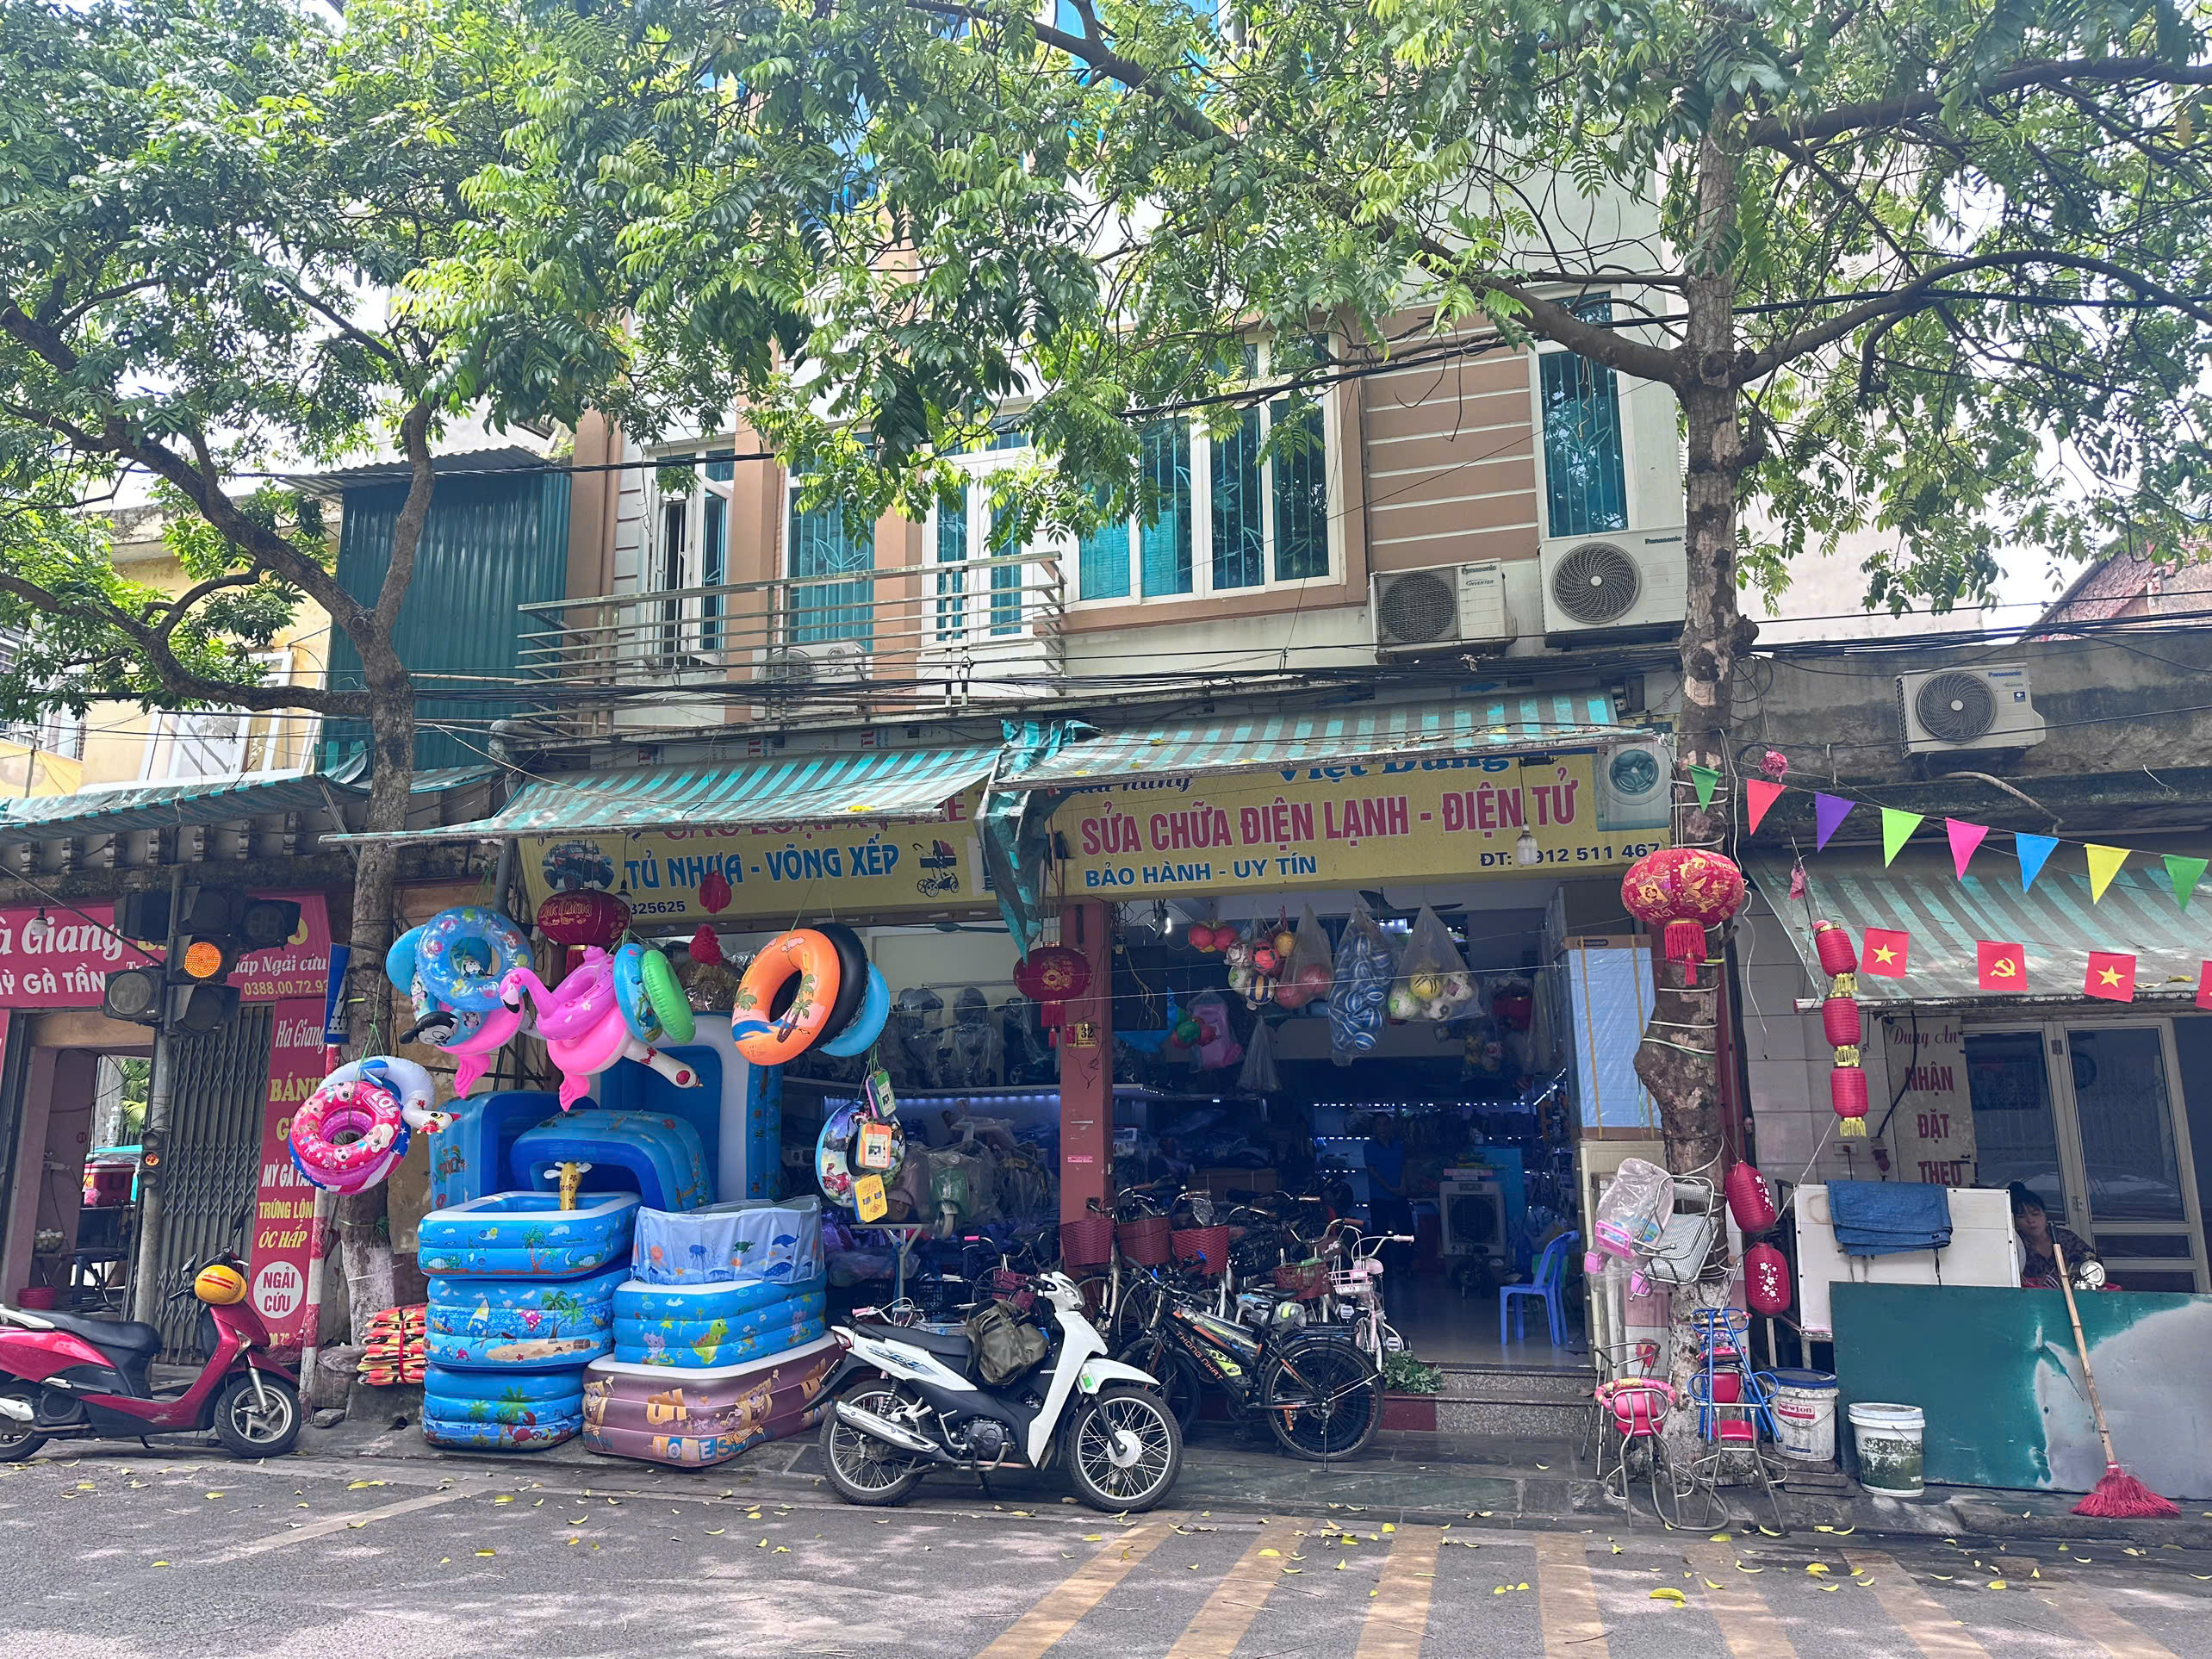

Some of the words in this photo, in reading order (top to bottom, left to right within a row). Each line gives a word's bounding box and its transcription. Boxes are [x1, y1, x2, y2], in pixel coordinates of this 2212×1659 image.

[1645, 536, 1681, 544] Panasonic
[1462, 565, 1496, 575] Panasonic
[1081, 801, 1143, 855] SỬA
[1150, 800, 1233, 851] CHỮA
[1240, 796, 1315, 851] ĐIỆN
[1324, 795, 1409, 848] LẠNH
[1442, 781, 1524, 839] ĐIỆN
[1531, 767, 1579, 827] TỬ
[624, 849, 661, 890] TỦ
[765, 842, 842, 881] VÕNG
[848, 833, 900, 877] XẾP
[1480, 851, 1512, 867] ĐT:
[1535, 848, 1569, 864] 912
[1576, 846, 1613, 861] 511
[1621, 843, 1661, 858] 467
[1084, 861, 1135, 888] BẢO
[1142, 861, 1211, 885] HÀNH
[1233, 859, 1268, 879] UY
[1275, 852, 1317, 875] TÍN
[0, 916, 13, 955] à
[22, 916, 123, 961] Giang
[262, 954, 297, 976] Ngải
[300, 953, 326, 972] cứu
[0, 969, 16, 995] Ỳ
[22, 967, 58, 995] GÀ
[62, 962, 106, 993] TẦN
[276, 1016, 292, 1048] Hà
[294, 1018, 326, 1054] Giang
[1904, 1061, 1954, 1097] NHẬN
[1917, 1108, 1949, 1144] ĐẶT
[261, 1158, 279, 1187] MỲ
[1917, 1160, 1962, 1186] THEO
[259, 1198, 291, 1220] TRỨNG
[293, 1197, 314, 1223] LỘN
[258, 1226, 278, 1248] ÓC
[278, 1223, 308, 1249] HẤP
[263, 1266, 295, 1289] NGẢI
[264, 1292, 291, 1313] CỨU
[1177, 1330, 1202, 1358] THONG
[1201, 1358, 1224, 1380] NHAT
[1779, 1402, 1812, 1414] Newton
